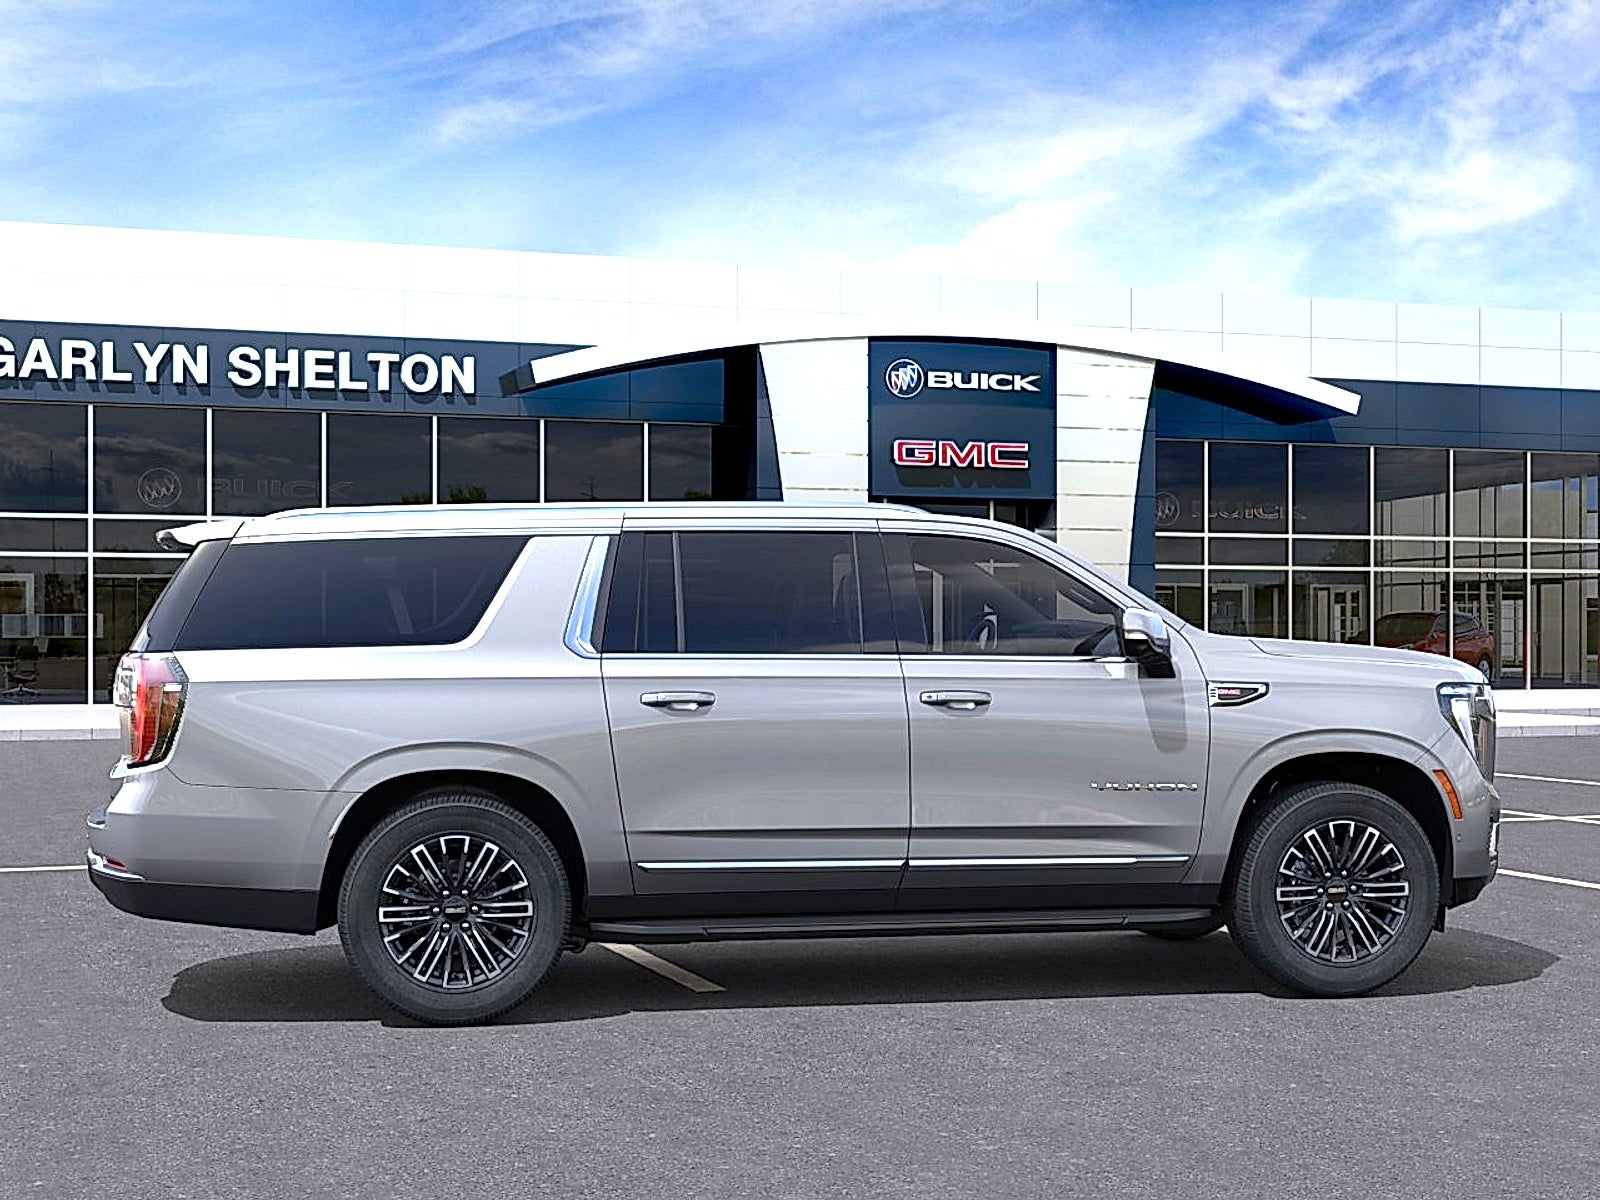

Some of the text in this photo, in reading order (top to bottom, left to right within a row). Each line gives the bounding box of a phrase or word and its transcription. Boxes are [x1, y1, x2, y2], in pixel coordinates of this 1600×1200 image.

[227, 346, 475, 394] SHELTON
[927, 370, 1042, 392] BUICK
[893, 439, 1029, 469] GMC
[1090, 781, 1198, 792] YUKON
